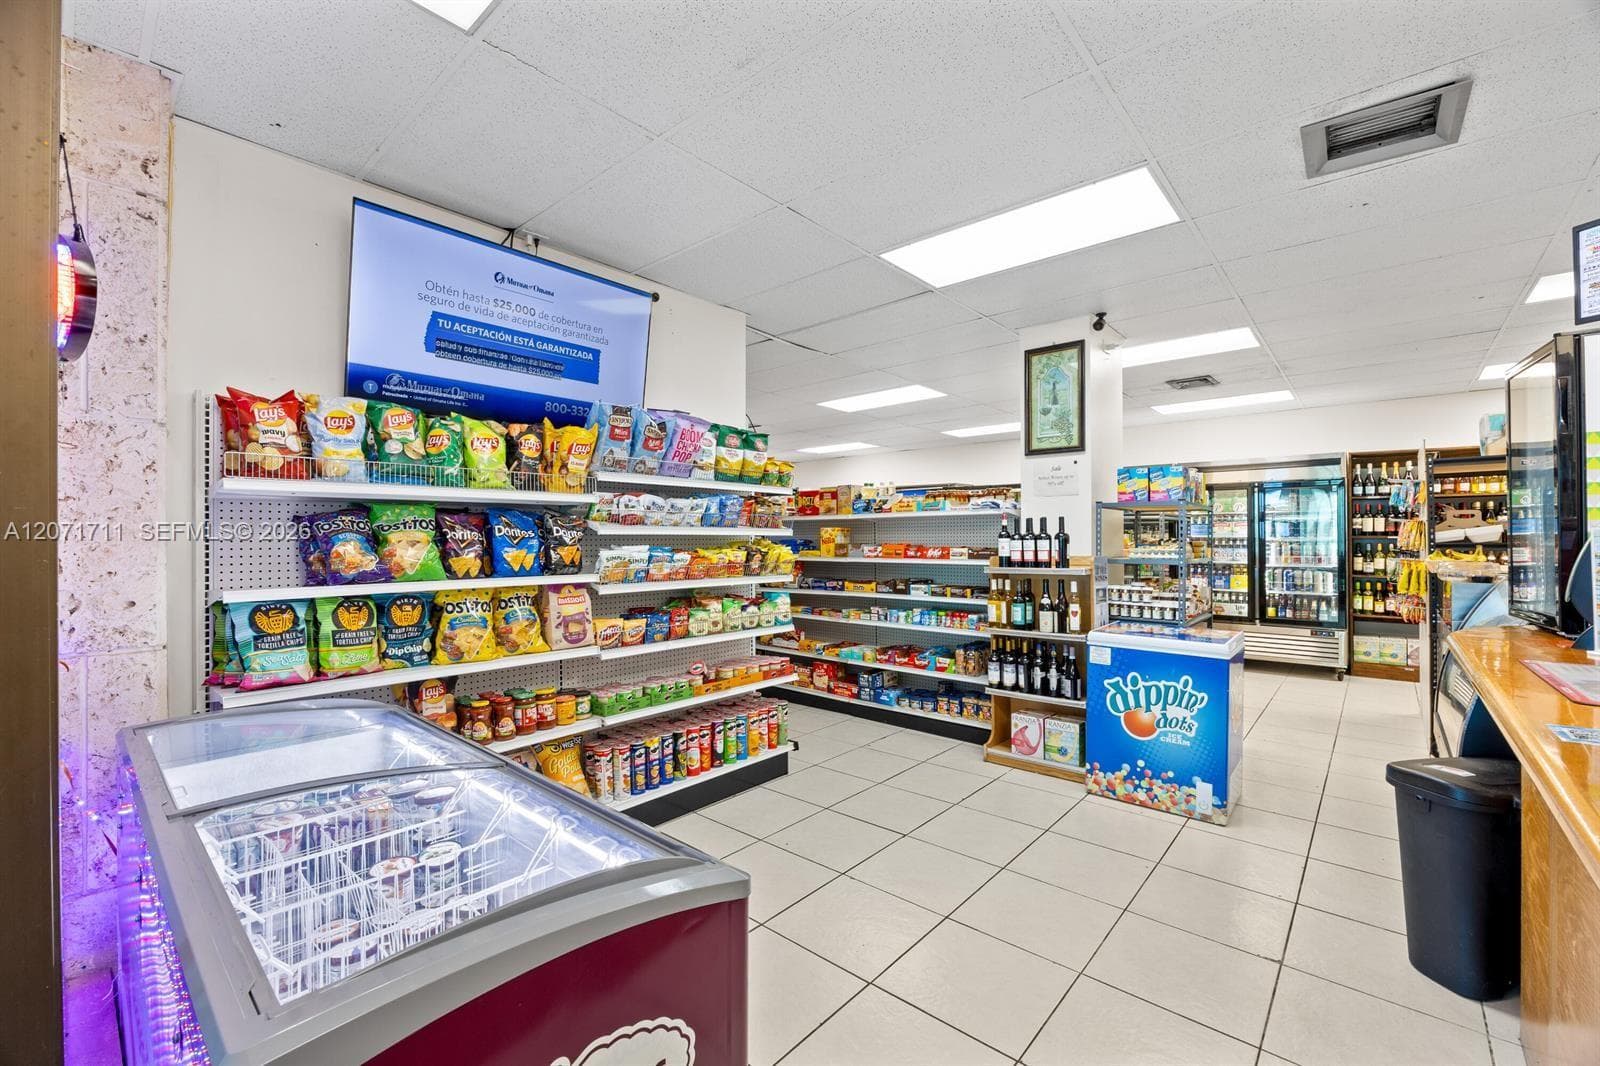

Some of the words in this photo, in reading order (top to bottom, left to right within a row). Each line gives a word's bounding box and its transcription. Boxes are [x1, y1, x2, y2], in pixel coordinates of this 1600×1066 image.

[425, 280, 459, 297] Obtén
[462, 289, 490, 306] hasta
[493, 298, 536, 316] $25,000
[538, 311, 549, 320] de
[552, 315, 592, 332] cobertura
[417, 292, 455, 308] seguro
[458, 300, 470, 312] de
[474, 306, 494, 318] vida
[497, 310, 510, 321] de
[512, 315, 560, 334] aceptación
[562, 328, 609, 346] garantizada
[437, 318, 452, 329] TU
[453, 323, 512, 342] ACEPTACIÓN
[514, 334, 535, 347] ESTÁ
[536, 341, 594, 360] GARANTIZADA
[254, 406, 286, 422] Lay's
[387, 412, 413, 427] Lay's
[326, 415, 354, 430] Lay's
[260, 428, 286, 438] wavy
[426, 434, 451, 448] Lay's
[520, 439, 542, 452] Lay's
[672, 452, 692, 463] POP
[494, 525, 535, 538] Doritos
[258, 641, 286, 649] TORTILLA
[286, 638, 304, 646] CHIPS
[263, 634, 281, 643] GRAIN
[282, 632, 297, 640] FREE
[336, 638, 360, 646] TORTILLA
[388, 646, 404, 657] Dip
[404, 644, 422, 654] Chip
[422, 684, 444, 700] Lay's
[1104, 672, 1208, 716] dippin'
[1014, 714, 1037, 726] RANZIA
[1046, 720, 1072, 730] RANZIA
[1156, 712, 1197, 736] dots
[1160, 736, 1191, 746] CREAM
